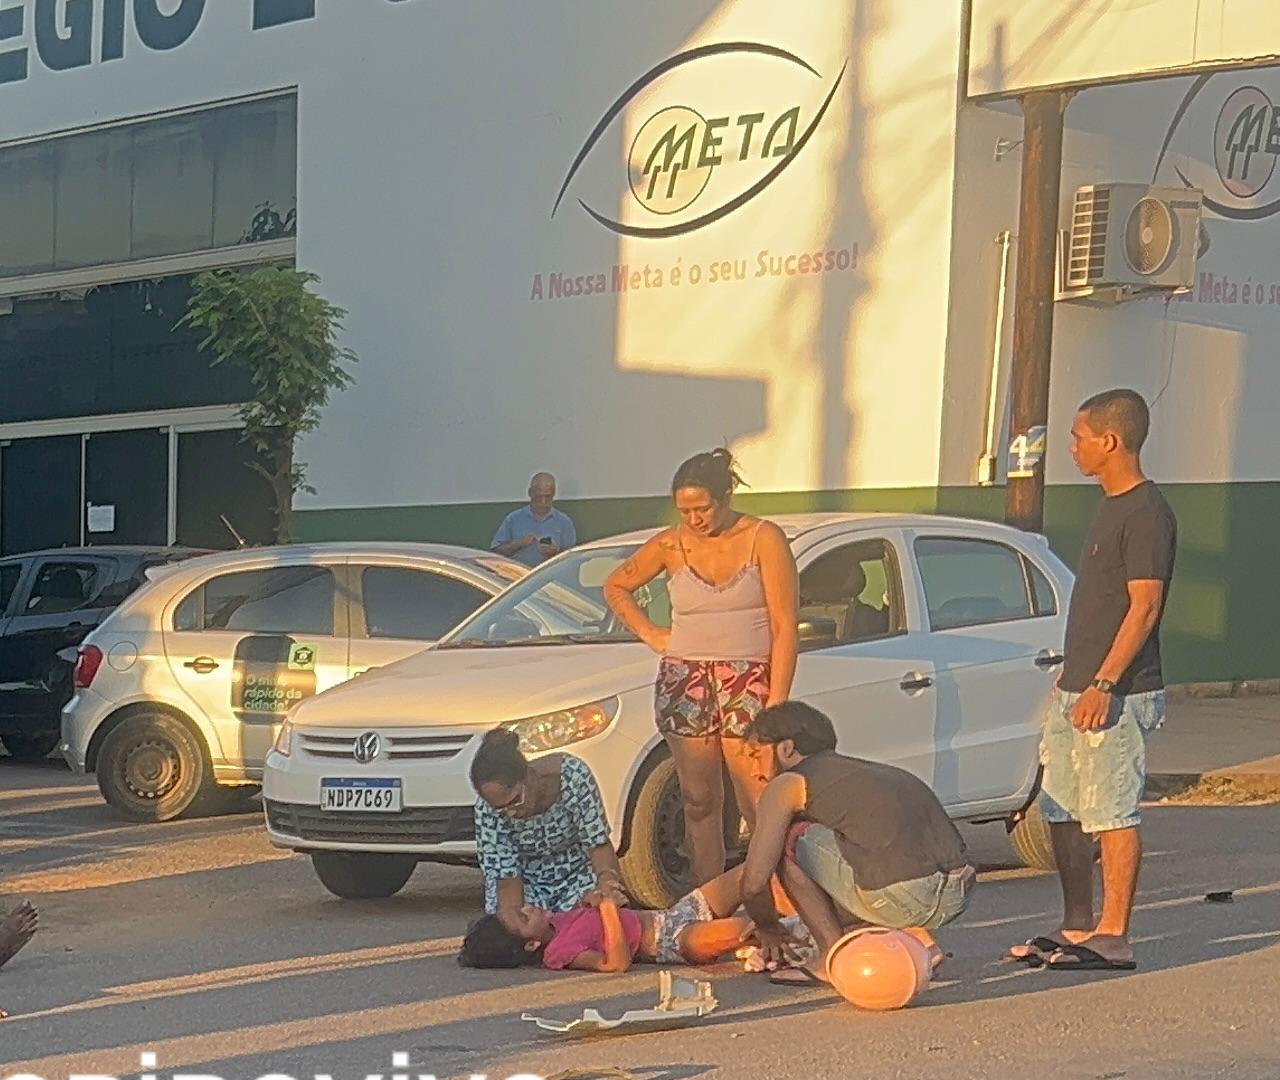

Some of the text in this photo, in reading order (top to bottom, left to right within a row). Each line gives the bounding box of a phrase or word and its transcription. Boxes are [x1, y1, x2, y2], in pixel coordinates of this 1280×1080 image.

[643, 105, 800, 200] META
[531, 242, 858, 300] A Nossa Meta é o seu Sucesso!
[1199, 272, 1238, 304] Meta
[244, 687, 302, 700] rápido da
